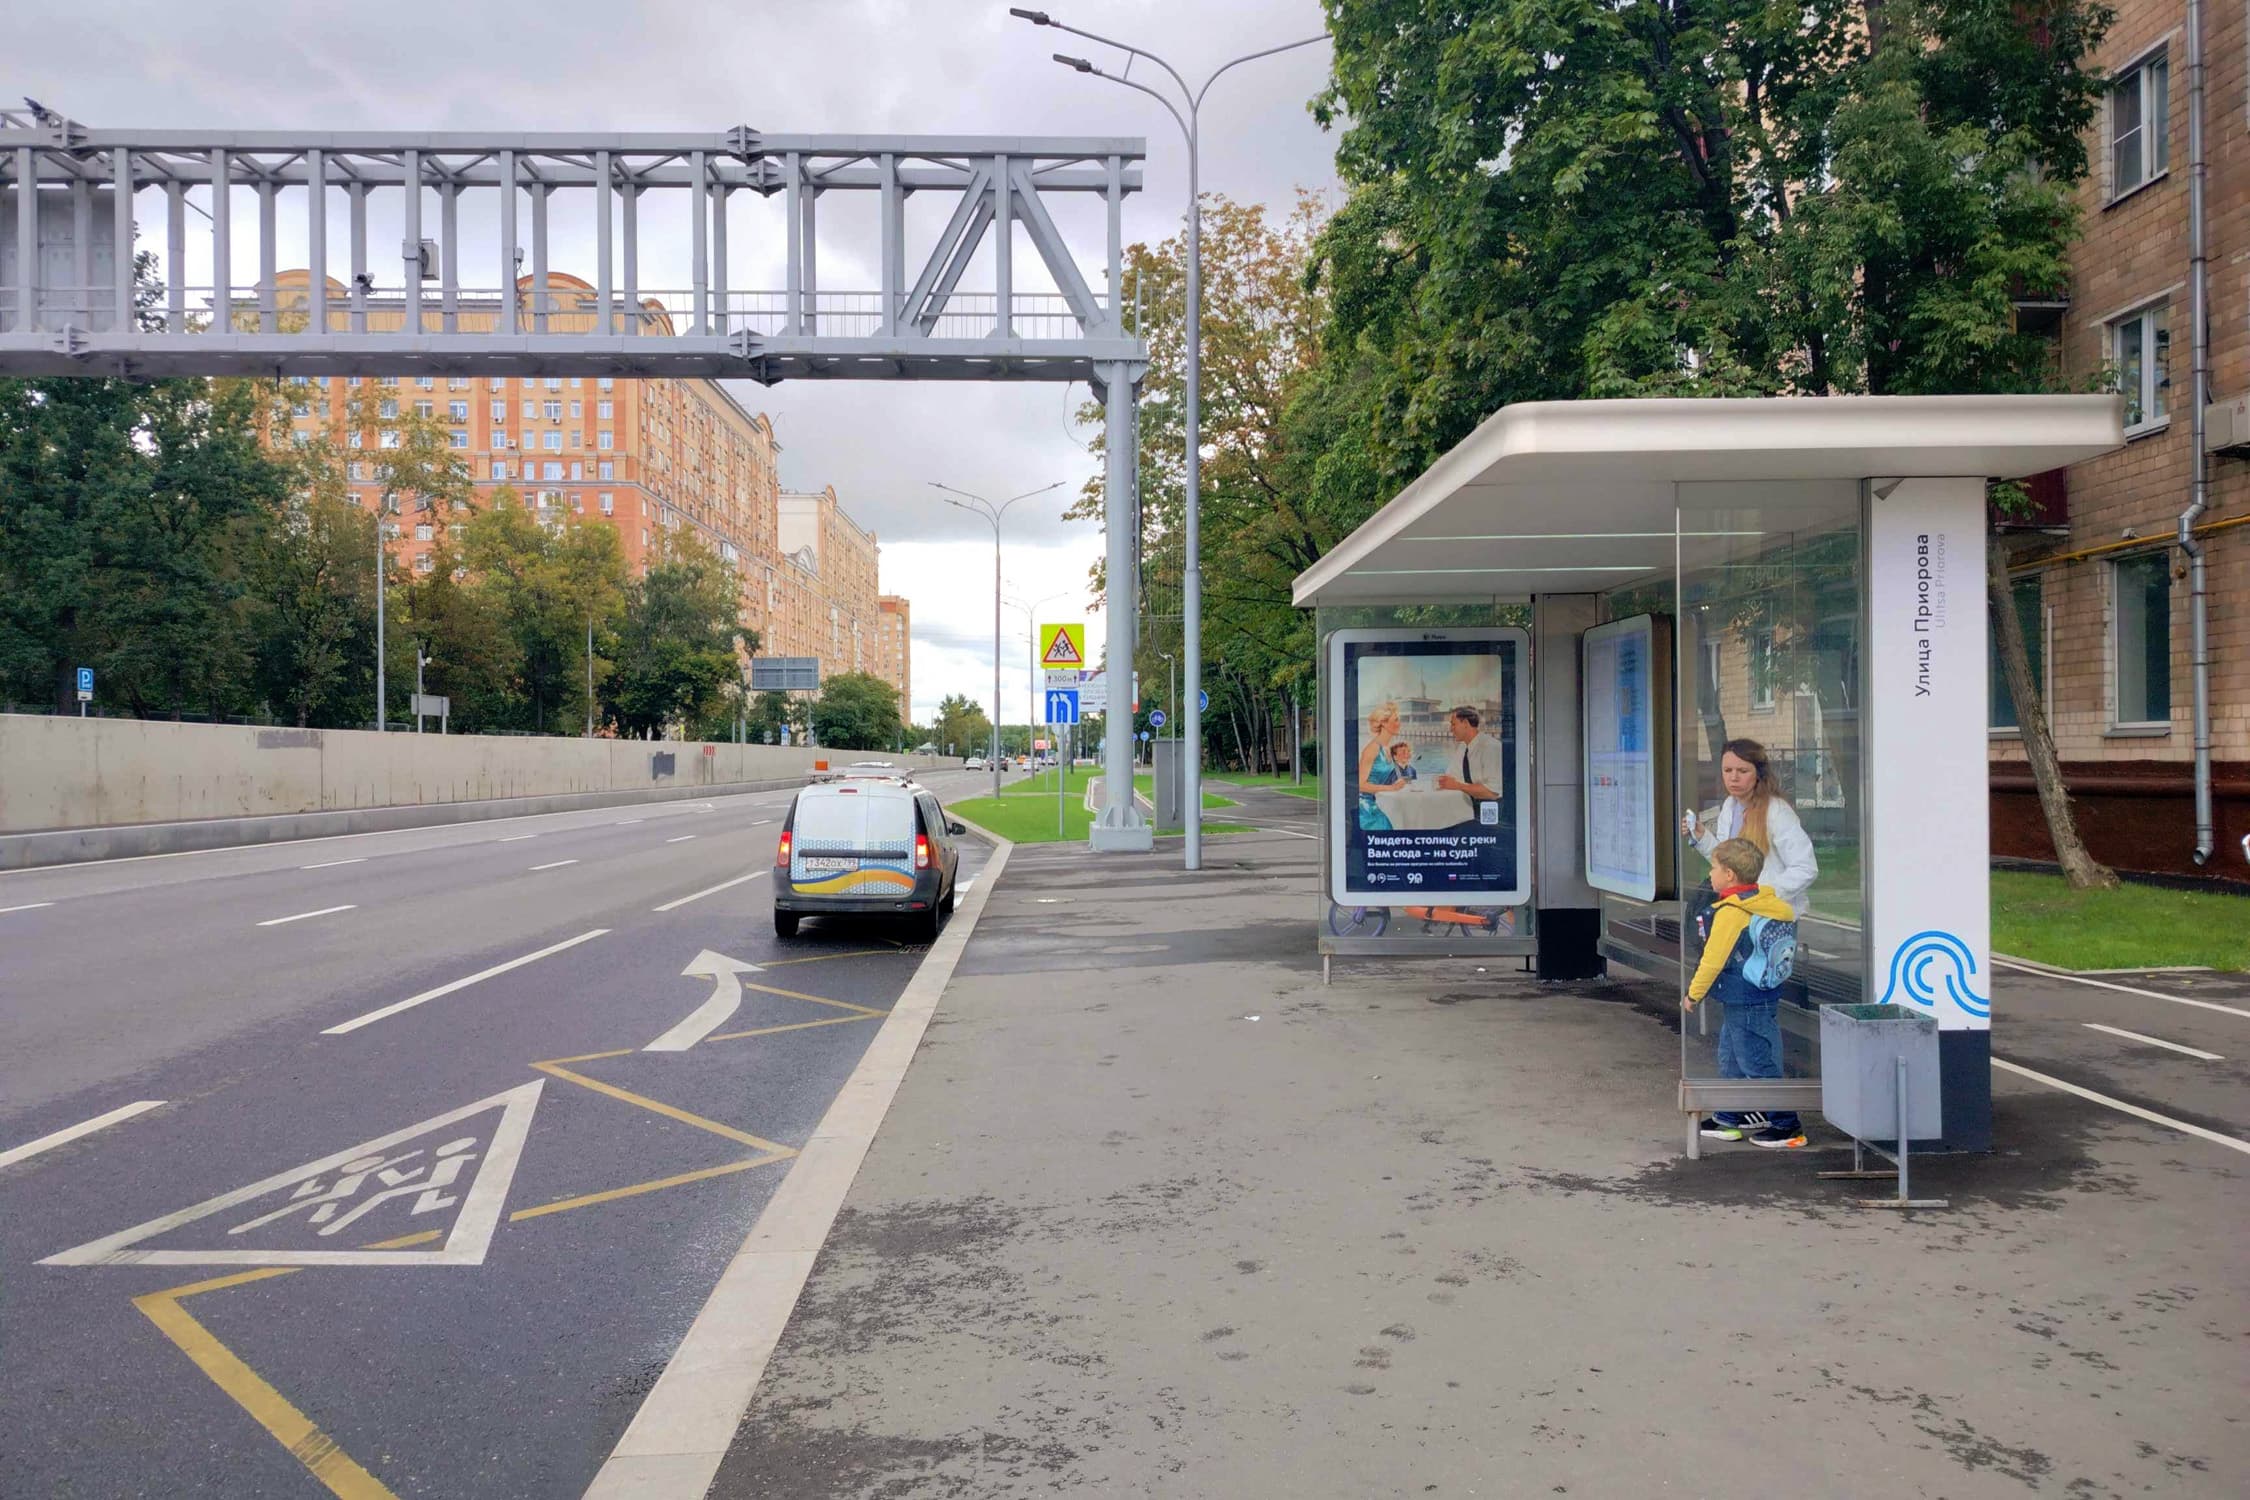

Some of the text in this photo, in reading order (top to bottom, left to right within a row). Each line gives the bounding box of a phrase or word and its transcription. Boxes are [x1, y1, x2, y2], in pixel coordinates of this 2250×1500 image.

[1935, 533, 1946, 628] Ulitsa Priorova
[1914, 534, 1933, 697] Улица Приорова
[1367, 835, 1497, 846] Увидеть столицу с реки
[1367, 848, 1390, 858] Вам
[1392, 849, 1421, 859] сюда
[1433, 849, 1447, 858] на
[1449, 847, 1478, 859] суда!
